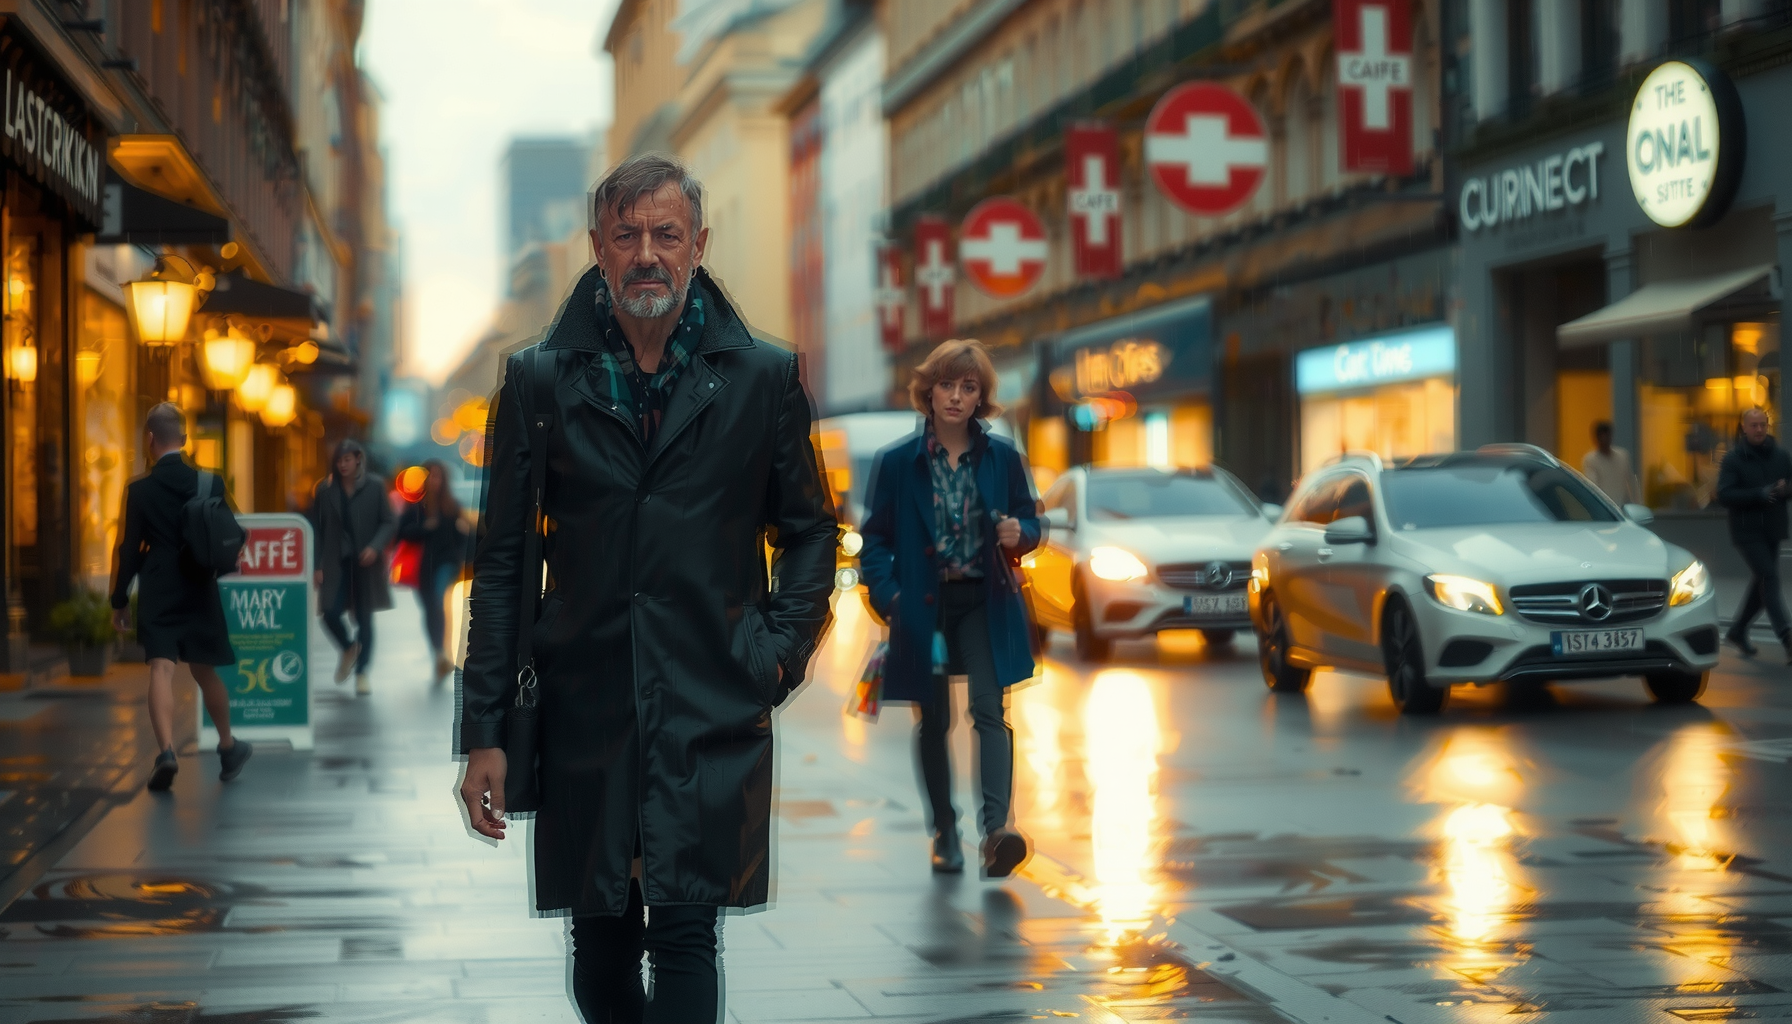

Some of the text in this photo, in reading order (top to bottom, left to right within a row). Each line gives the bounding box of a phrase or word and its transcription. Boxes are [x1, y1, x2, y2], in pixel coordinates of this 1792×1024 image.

[1655, 80, 1686, 110] THE
[1635, 115, 1710, 175] ONAL
[240, 530, 297, 568] AFFÉ
[230, 588, 286, 610] MARY
[237, 608, 282, 630] WAL
